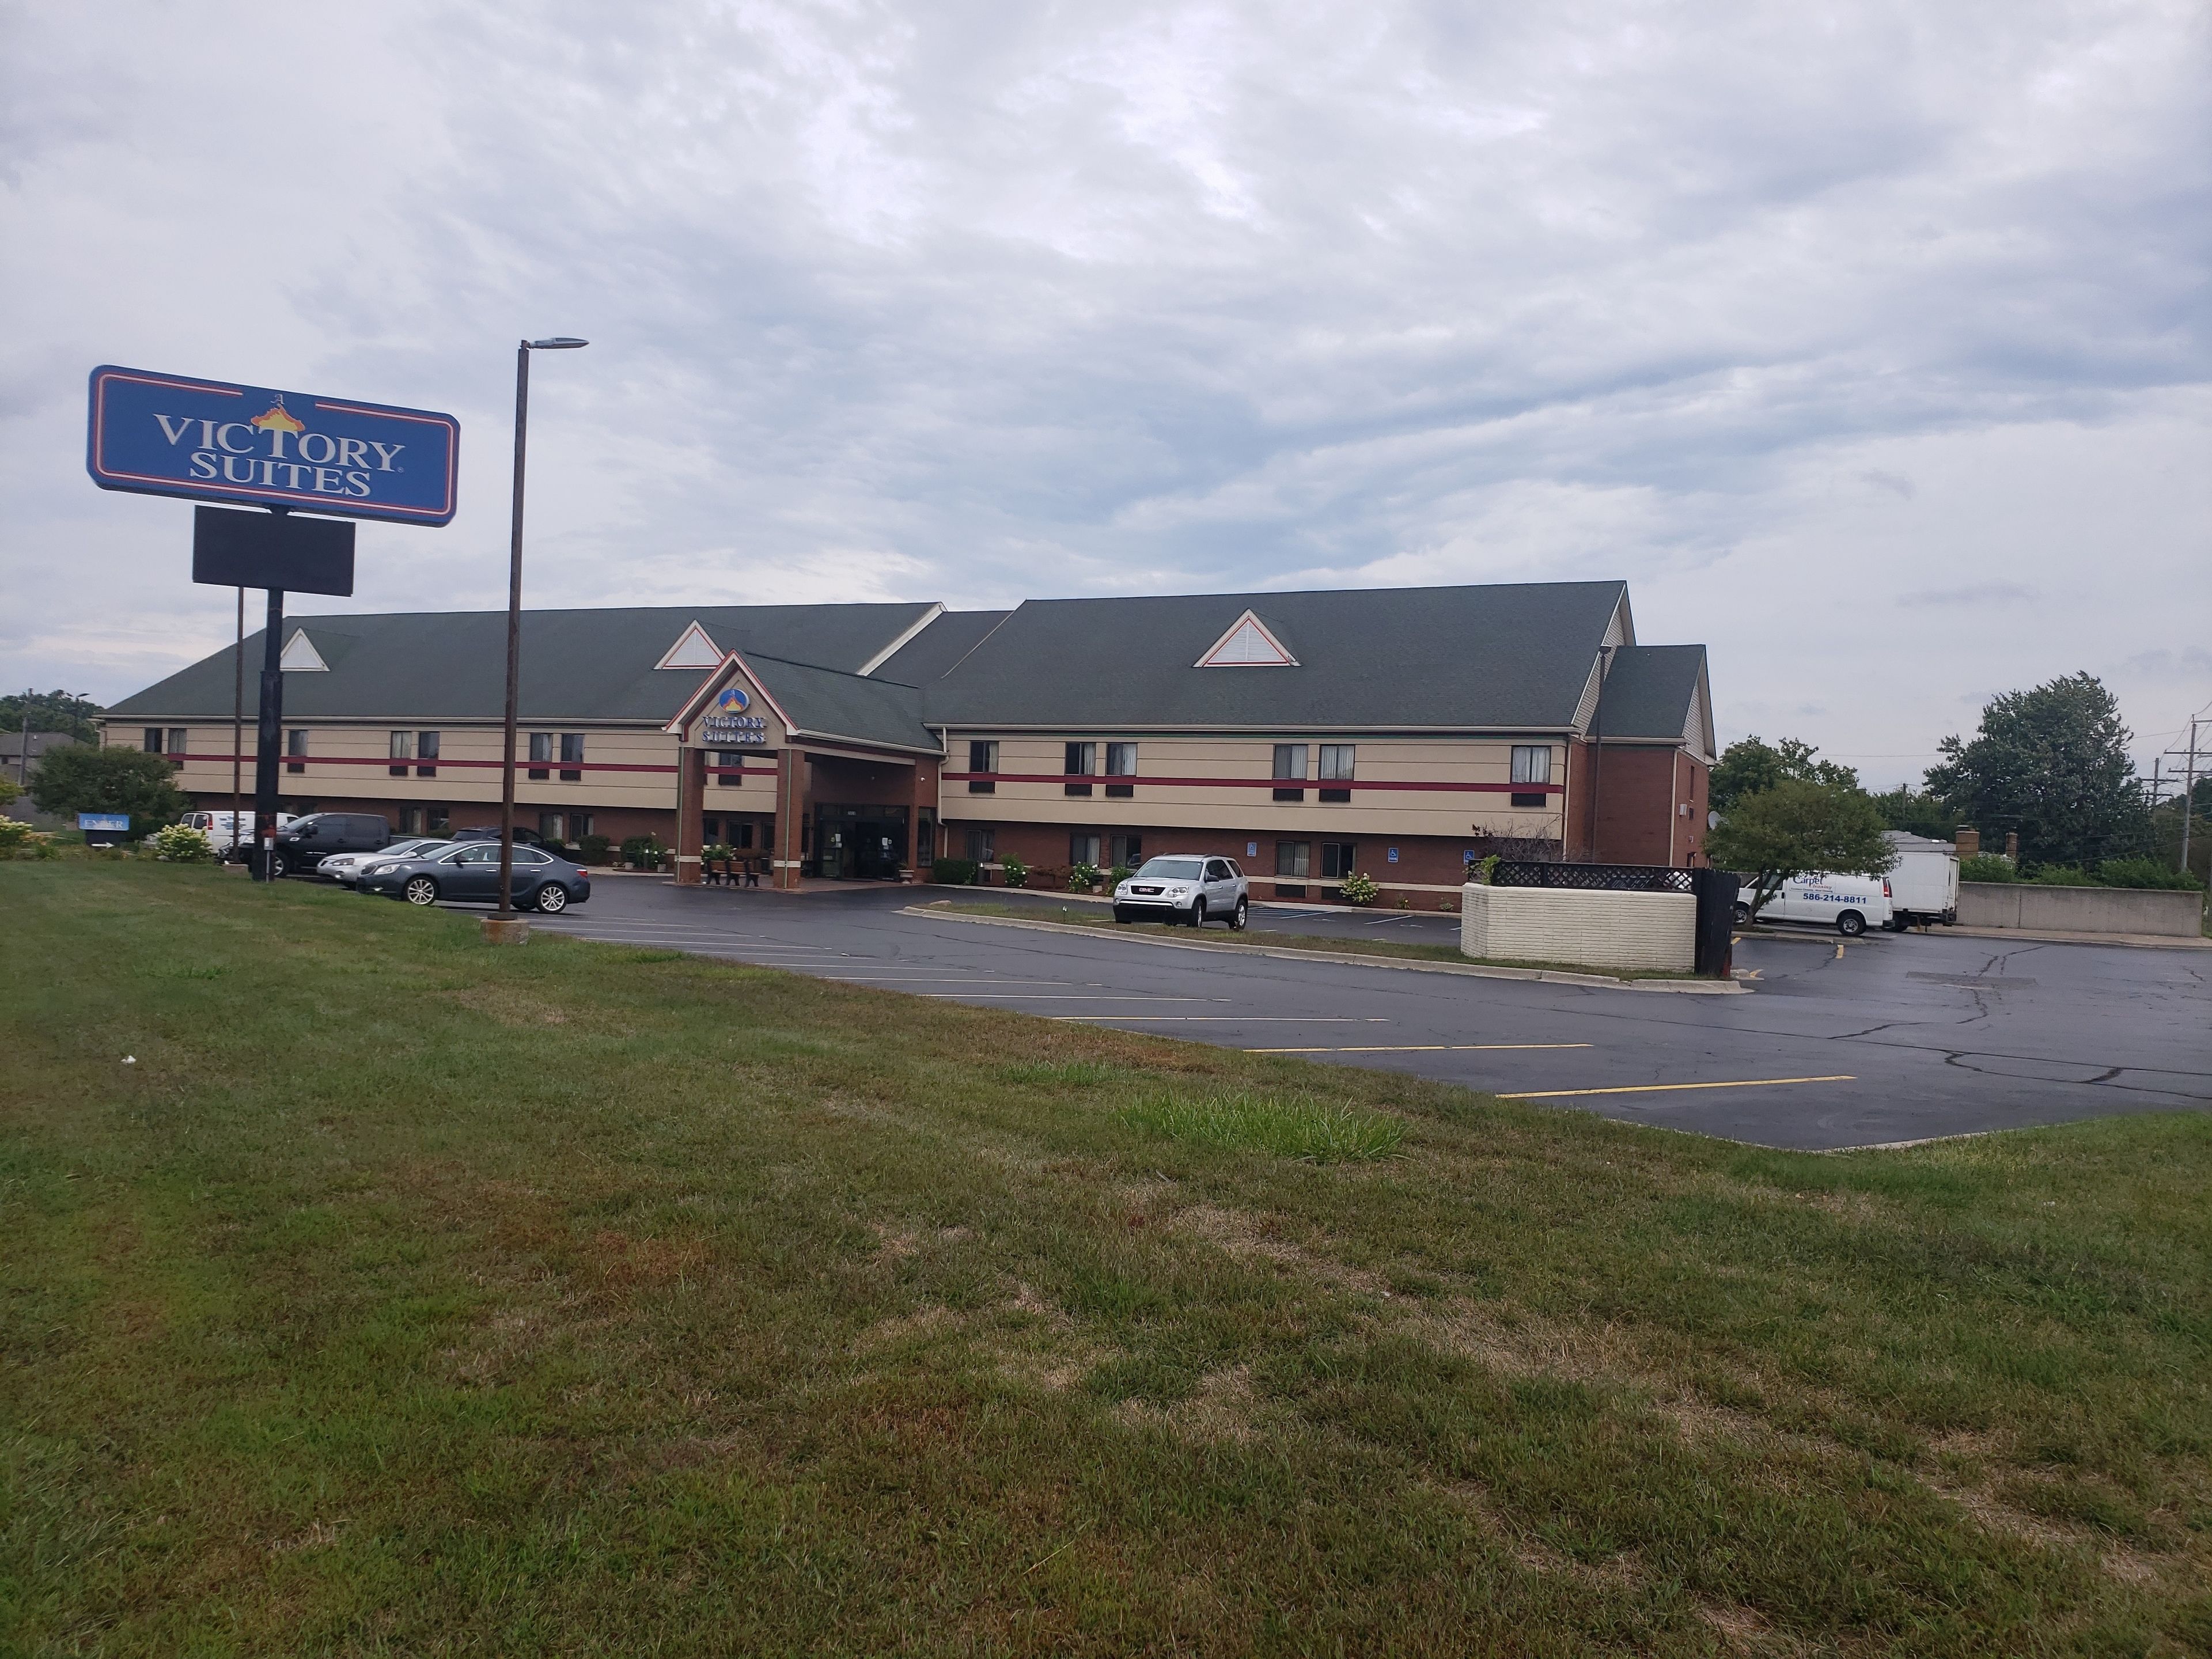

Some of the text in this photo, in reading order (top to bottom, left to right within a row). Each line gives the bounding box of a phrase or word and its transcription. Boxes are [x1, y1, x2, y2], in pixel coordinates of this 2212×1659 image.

[153, 414, 406, 472] VICTORY
[190, 452, 371, 497] SUITES
[702, 716, 767, 729] VICTORY
[702, 731, 766, 743] SUITES
[84, 820, 123, 828] ENER
[1803, 893, 1866, 904] 586-214-8811
